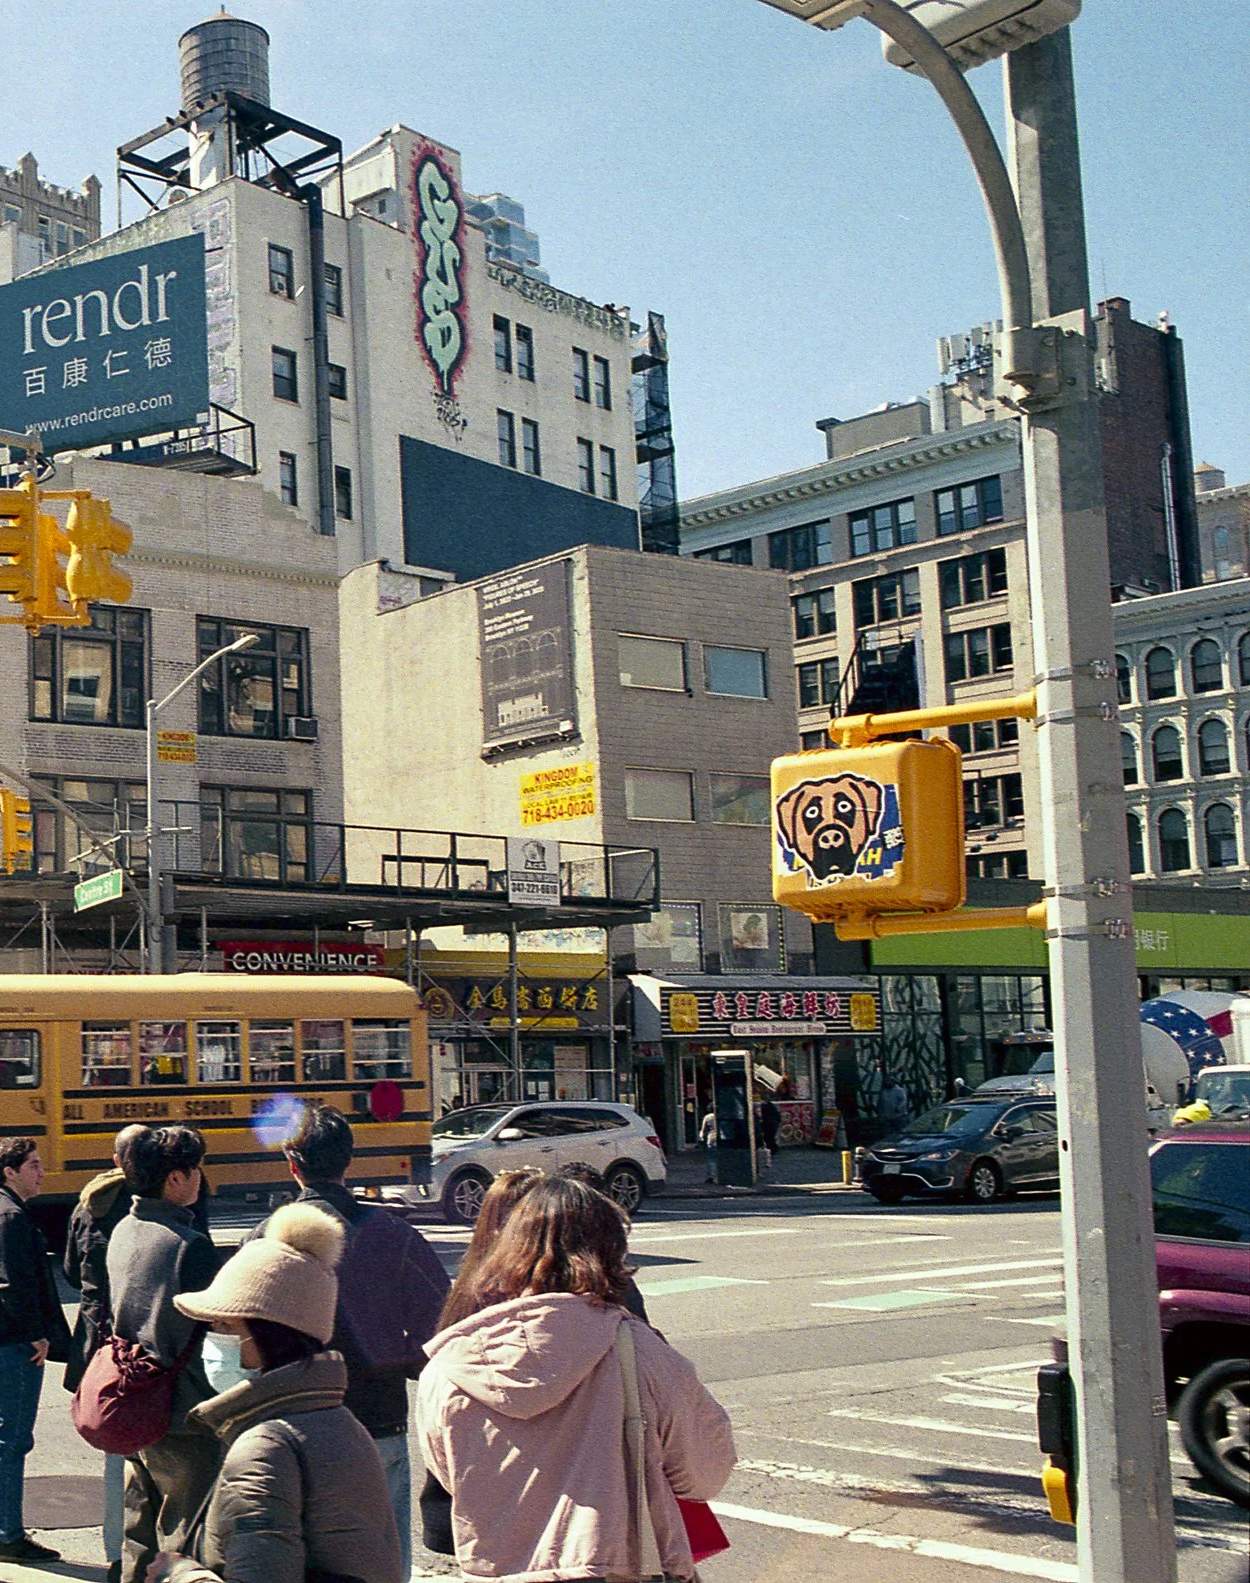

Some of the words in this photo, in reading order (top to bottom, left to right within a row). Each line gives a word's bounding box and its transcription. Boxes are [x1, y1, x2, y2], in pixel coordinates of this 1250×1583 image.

[22, 264, 177, 355] rendr
[22, 337, 173, 398] 百康仁德
[24, 393, 173, 435] www.rendrcare.com
[523, 776, 593, 794] WATERPROOFING
[534, 767, 578, 783] KINGDOM
[522, 800, 594, 824] 718-434-0020
[1135, 929, 1170, 951] 銀行
[232, 952, 377, 972] CONVENIENCE
[63, 1104, 84, 1120] ALL
[102, 1102, 170, 1118] AMERICAN
[185, 1100, 233, 1116] SCHOOL
